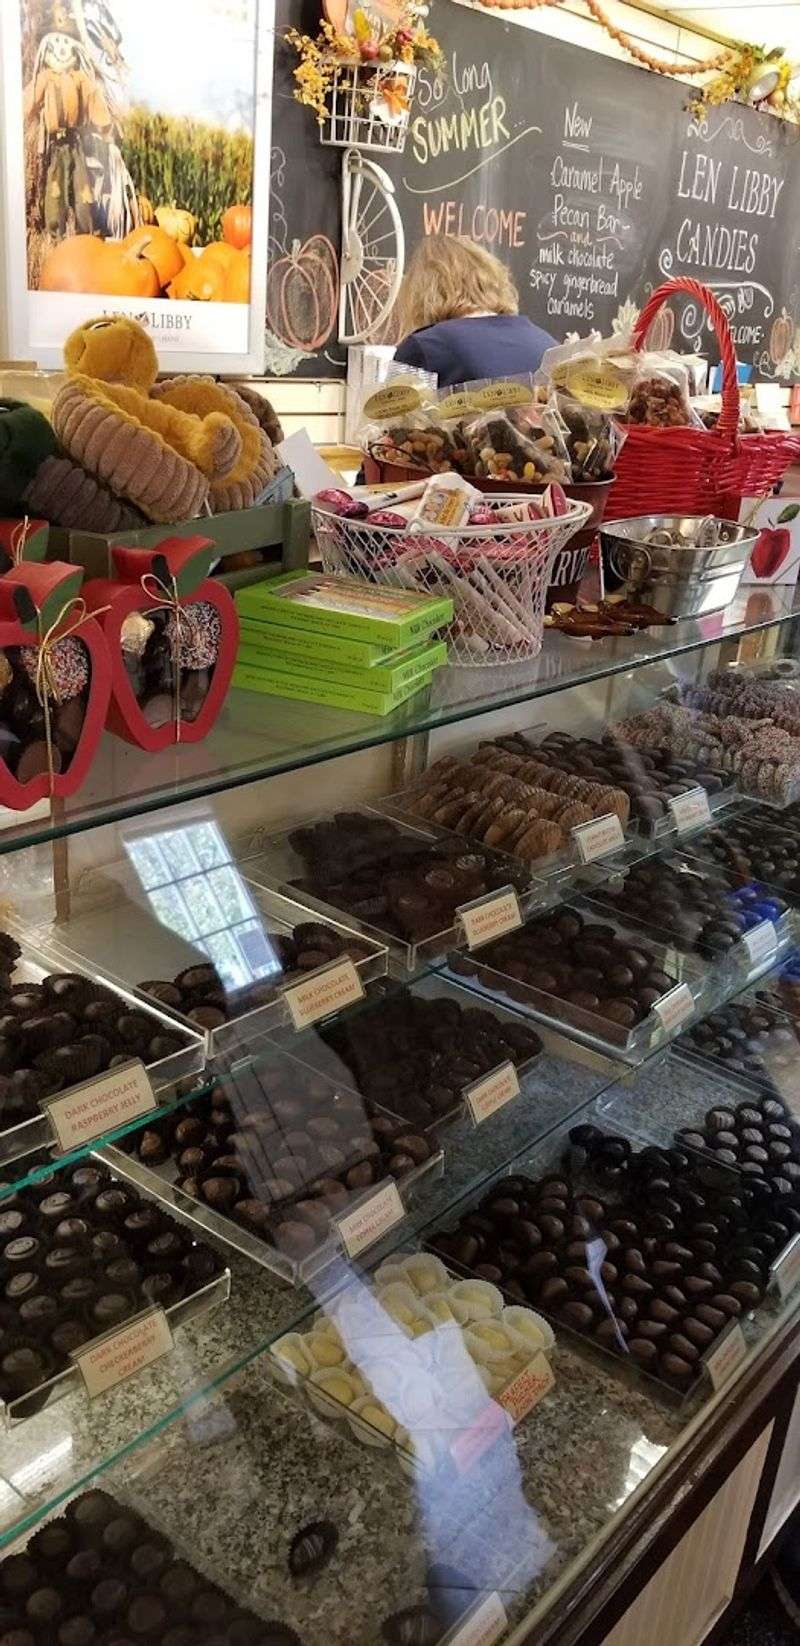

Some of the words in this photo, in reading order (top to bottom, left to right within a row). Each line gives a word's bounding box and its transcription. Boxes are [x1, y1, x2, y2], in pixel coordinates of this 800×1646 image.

[418, 66, 443, 106] So
[453, 51, 493, 107] long
[564, 102, 592, 138] New
[551, 155, 603, 193] Caramel
[610, 163, 643, 210] Apple
[678, 150, 722, 205] LEN
[728, 166, 785, 218] LIBBY
[423, 201, 527, 248] WELCOME
[552, 194, 590, 228] Pecan
[539, 243, 565, 265] milk
[568, 245, 614, 270] chocolate
[570, 231, 592, 247] and
[676, 218, 759, 274] CANDIES
[530, 268, 556, 297] spicy
[563, 271, 619, 298] gingerbread
[151, 312, 193, 330] LIBBY
[547, 298, 595, 320] caramels
[64, 1103, 89, 1120] DARK
[89, 1079, 138, 1109] CHOCOLATE
[71, 1103, 119, 1132] RASPBERRY
[120, 1094, 142, 1110] JELLY
[112, 1319, 158, 1350] CHOCOLATE
[119, 1355, 145, 1377] CREAM
